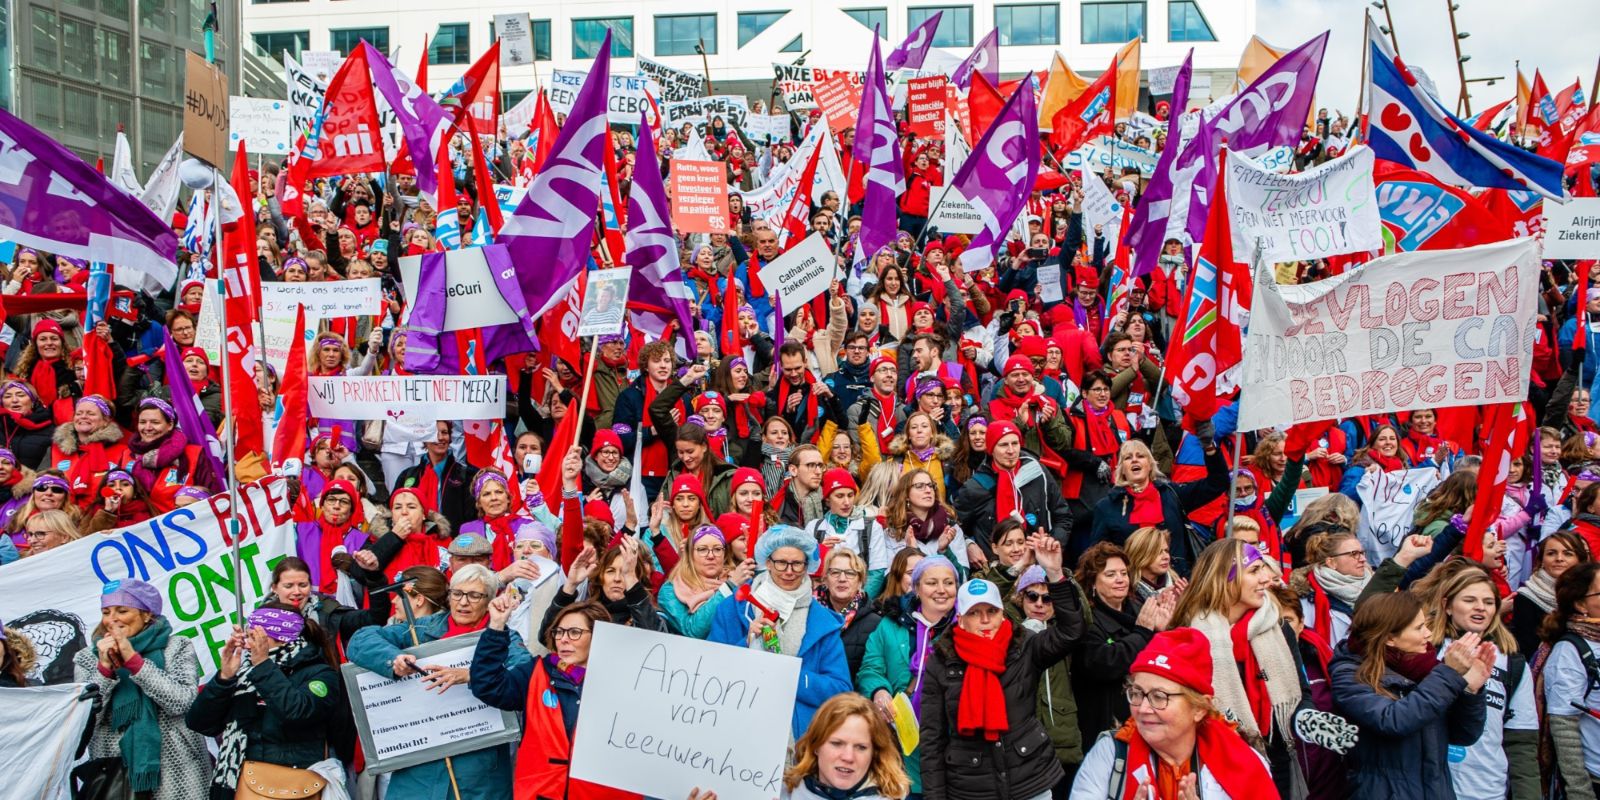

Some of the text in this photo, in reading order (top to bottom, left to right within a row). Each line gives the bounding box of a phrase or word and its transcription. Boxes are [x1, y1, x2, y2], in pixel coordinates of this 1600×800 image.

[639, 60, 656, 73] VAN
[774, 65, 811, 82] ONZE
[553, 72, 581, 86] DEZE
[612, 78, 622, 89] IS
[626, 79, 649, 91] NET
[910, 79, 945, 91] Waar blijft
[609, 96, 650, 114] CEBO
[911, 93, 927, 101] onze
[912, 101, 945, 112] financiële
[912, 111, 940, 123] injectie?
[676, 162, 720, 173] Rutte, wees
[677, 175, 720, 184] geen krent!
[677, 184, 721, 194] Investeer in
[678, 194, 715, 205] verpleger
[941, 201, 975, 210] Ziekenh
[678, 205, 720, 216] en patiënt!
[1571, 216, 1600, 229] Alrijn
[778, 255, 817, 284] Catharina
[782, 264, 825, 296] Ziekenhuis
[312, 286, 328, 294] ons
[1274, 331, 1348, 382] DOOR
[1369, 321, 1432, 371] DE
[404, 379, 432, 402] HET
[462, 379, 499, 404] MEER!
[1290, 357, 1520, 422] BEDROGEN
[91, 508, 208, 585] ONS
[634, 643, 761, 710] Antoni
[399, 721, 409, 729] we
[409, 719, 421, 727] nu
[436, 712, 449, 721] een
[671, 704, 718, 727] van
[378, 736, 429, 755] aandacht?
[607, 711, 781, 792] Leeuwenhoek
